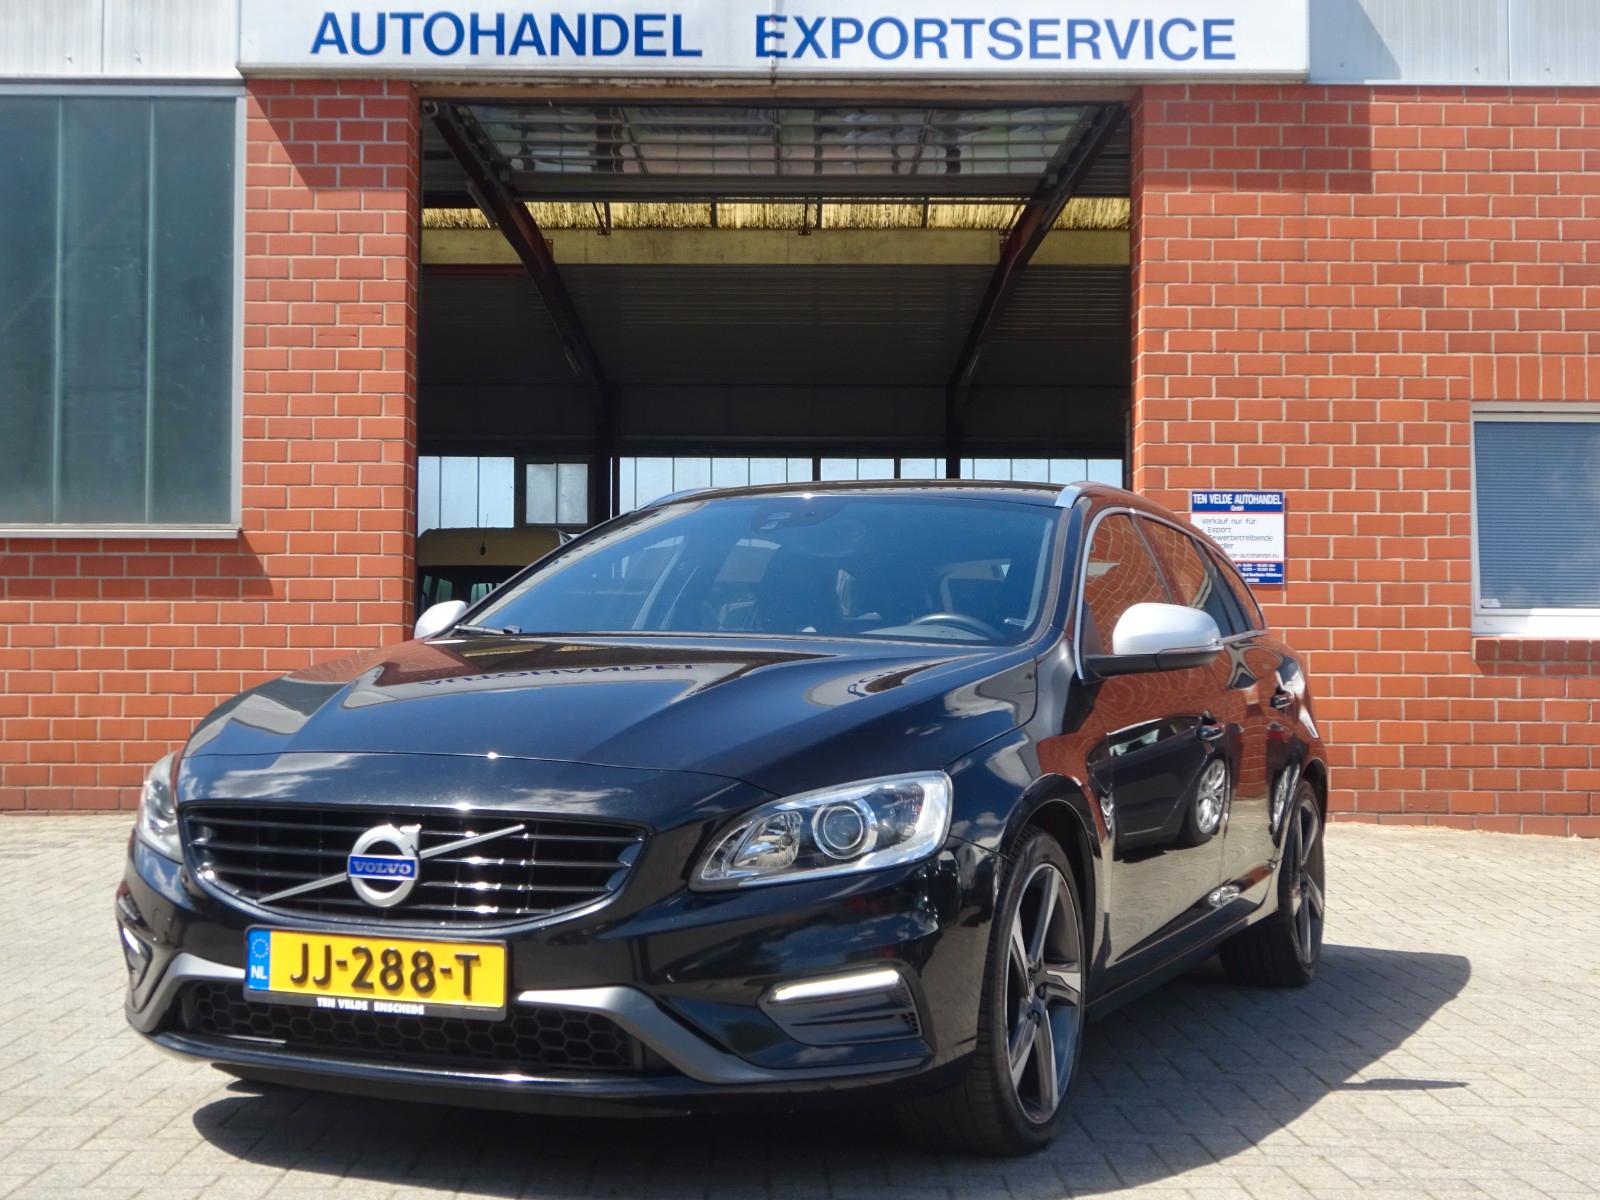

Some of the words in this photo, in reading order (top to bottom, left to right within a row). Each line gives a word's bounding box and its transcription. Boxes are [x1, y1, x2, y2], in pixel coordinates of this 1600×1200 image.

[310, 11, 703, 58] AUTOHANDEL
[755, 14, 1236, 61] EXPORTSERVICE
[1192, 493, 1208, 504] TEN
[1209, 493, 1233, 505] VELDE
[1234, 494, 1283, 505] AUTOHANDEL
[1201, 517, 1229, 525] Verkauf
[1245, 517, 1257, 525] für
[1207, 526, 1232, 534] Export
[352, 861, 412, 875] VOLVO
[251, 965, 267, 980] NL
[290, 942, 480, 997] JJ-288-T
[316, 997, 336, 1008] TEN
[338, 998, 369, 1012] VELDE
[373, 1001, 425, 1016] ENSCHEDE
